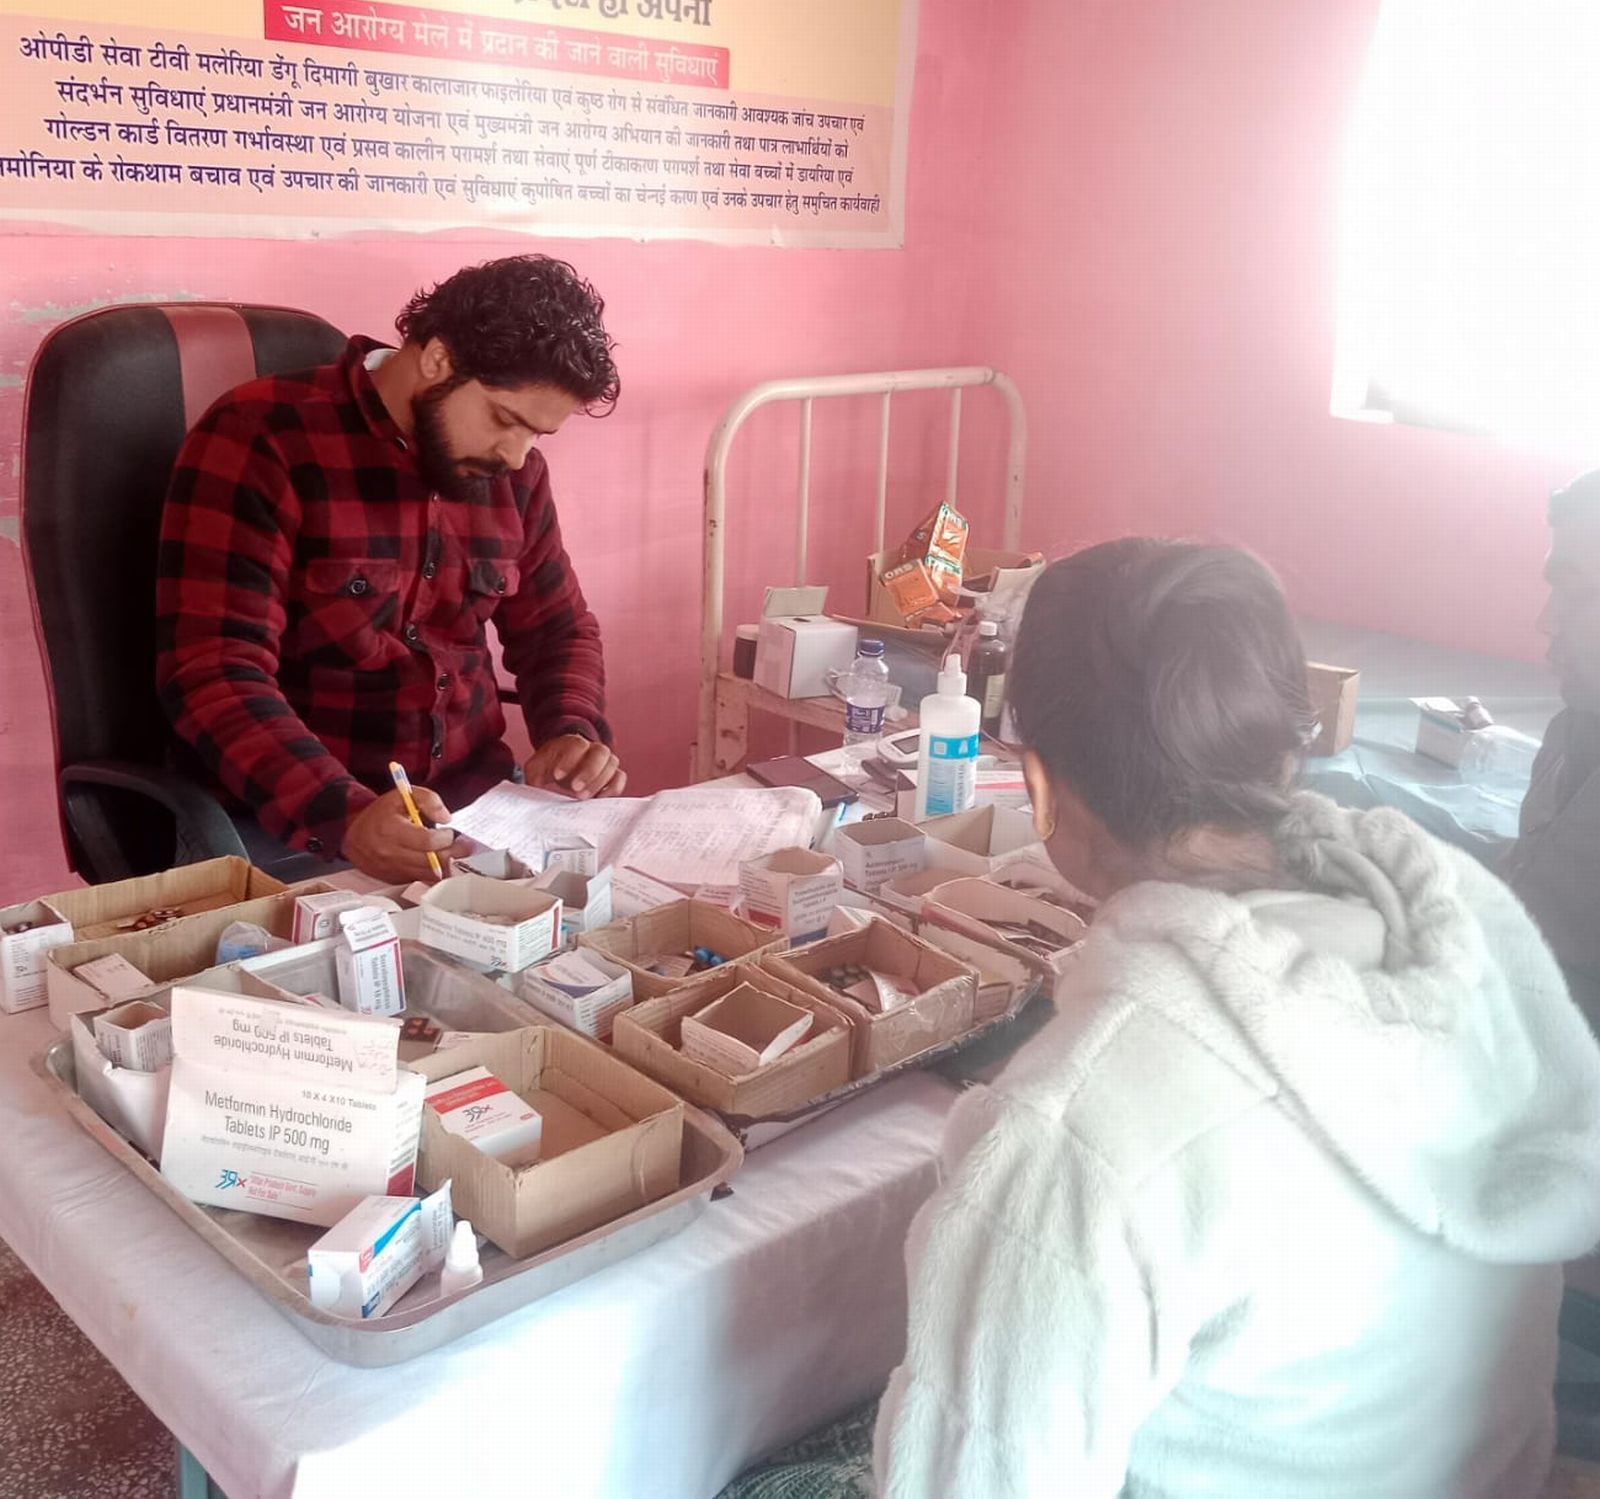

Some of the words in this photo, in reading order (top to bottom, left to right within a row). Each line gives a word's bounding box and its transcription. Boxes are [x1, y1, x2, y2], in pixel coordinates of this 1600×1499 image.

[281, 5, 322, 35] जन
[330, 6, 405, 43] आरोग्य
[413, 16, 449, 49] मेले
[457, 20, 478, 51] में
[480, 30, 528, 57] प्रदान
[533, 30, 560, 58] की
[565, 36, 602, 65] जाने
[608, 42, 650, 71] वाली
[654, 47, 719, 86] सुविधाएं
[20, 31, 93, 64] ओपीडी
[100, 37, 142, 67] सेवा
[148, 43, 190, 71] टीवी
[197, 48, 263, 78] मलेरिया
[269, 53, 301, 88] डेंगू
[303, 58, 360, 87] दिमागी
[363, 69, 410, 96] बुखार
[412, 75, 481, 97] कालाजार
[482, 78, 547, 105] फाइलेरिया
[552, 85, 573, 110] एवं
[576, 91, 604, 114] कुष्ठ
[608, 88, 626, 111] रोग
[631, 91, 642, 112] से
[692, 101, 738, 121] जानकारी
[741, 107, 789, 126] आवश्यक
[792, 109, 814, 127] जांच
[817, 114, 849, 130] उपचार
[850, 114, 865, 136] एवं
[55, 75, 122, 106] संदर्भन
[128, 82, 208, 117] सुविधाएं
[211, 91, 294, 118] प्रधानमंत्री
[300, 100, 327, 121] जन
[333, 98, 388, 124] आरोग्य
[393, 102, 441, 129] योजना
[446, 108, 470, 137] एवं
[474, 112, 532, 138] मुख्यमंत्री
[538, 119, 560, 138] जन
[565, 118, 607, 141] आरोग्य
[611, 122, 662, 145] अभियान
[665, 125, 682, 145] की
[686, 130, 730, 150] जानकारी
[734, 136, 755, 152] तथा
[759, 137, 779, 154] पात्र
[781, 136, 833, 157] लाभार्थियों
[835, 138, 849, 159] को
[44, 111, 111, 142] गोल्डन
[116, 117, 161, 145] कार्ड
[164, 118, 228, 149] वितरण
[233, 125, 315, 153] गर्भावस्था
[320, 131, 348, 161] एवं
[351, 139, 390, 159] प्रसव
[393, 137, 446, 163] कालीन
[450, 142, 498, 165] परामर्श
[501, 148, 528, 166] तथा
[534, 143, 571, 173] सेवाएं
[574, 148, 598, 175] पूर्ण
[602, 150, 658, 174] टीकाकरण
[663, 156, 700, 176] परामर्श
[704, 161, 725, 177] तथा
[728, 157, 751, 179] सेवा
[754, 160, 783, 181] बच्चों
[785, 161, 795, 181] में
[797, 163, 835, 183] डायरिया
[837, 166, 854, 188] एवं
[81, 154, 104, 181] के
[109, 154, 181, 184] रोकथाम
[187, 165, 242, 187] बचाव
[248, 164, 276, 193] एवं
[281, 169, 334, 192] उपचार
[337, 167, 360, 192] की
[364, 171, 429, 195] जानकारी
[434, 175, 458, 201] एवं
[462, 174, 518, 204] सुविधाएं
[521, 176, 573, 205] कुपोषित
[578, 180, 611, 202] बच्चों
[614, 186, 631, 203] का
[702, 188, 719, 210] एवं
[722, 187, 748, 207] उनके
[751, 193, 782, 209] उपचार
[785, 189, 800, 215] हेतु
[802, 191, 838, 216] समुचित
[840, 192, 881, 215] कार्यवाही
[232, 1018, 251, 1034] mg
[279, 1029, 291, 1044] IP
[294, 1031, 333, 1052] Tablets
[214, 1034, 291, 1060] Hydrochloride
[295, 1050, 353, 1074] Metformin
[205, 1090, 266, 1118] Metformin
[270, 1104, 352, 1133] Hydrochloride
[224, 1115, 265, 1140] Tablets
[269, 1124, 281, 1141] IP
[284, 1127, 307, 1147] 500
[310, 1138, 330, 1155] mg
